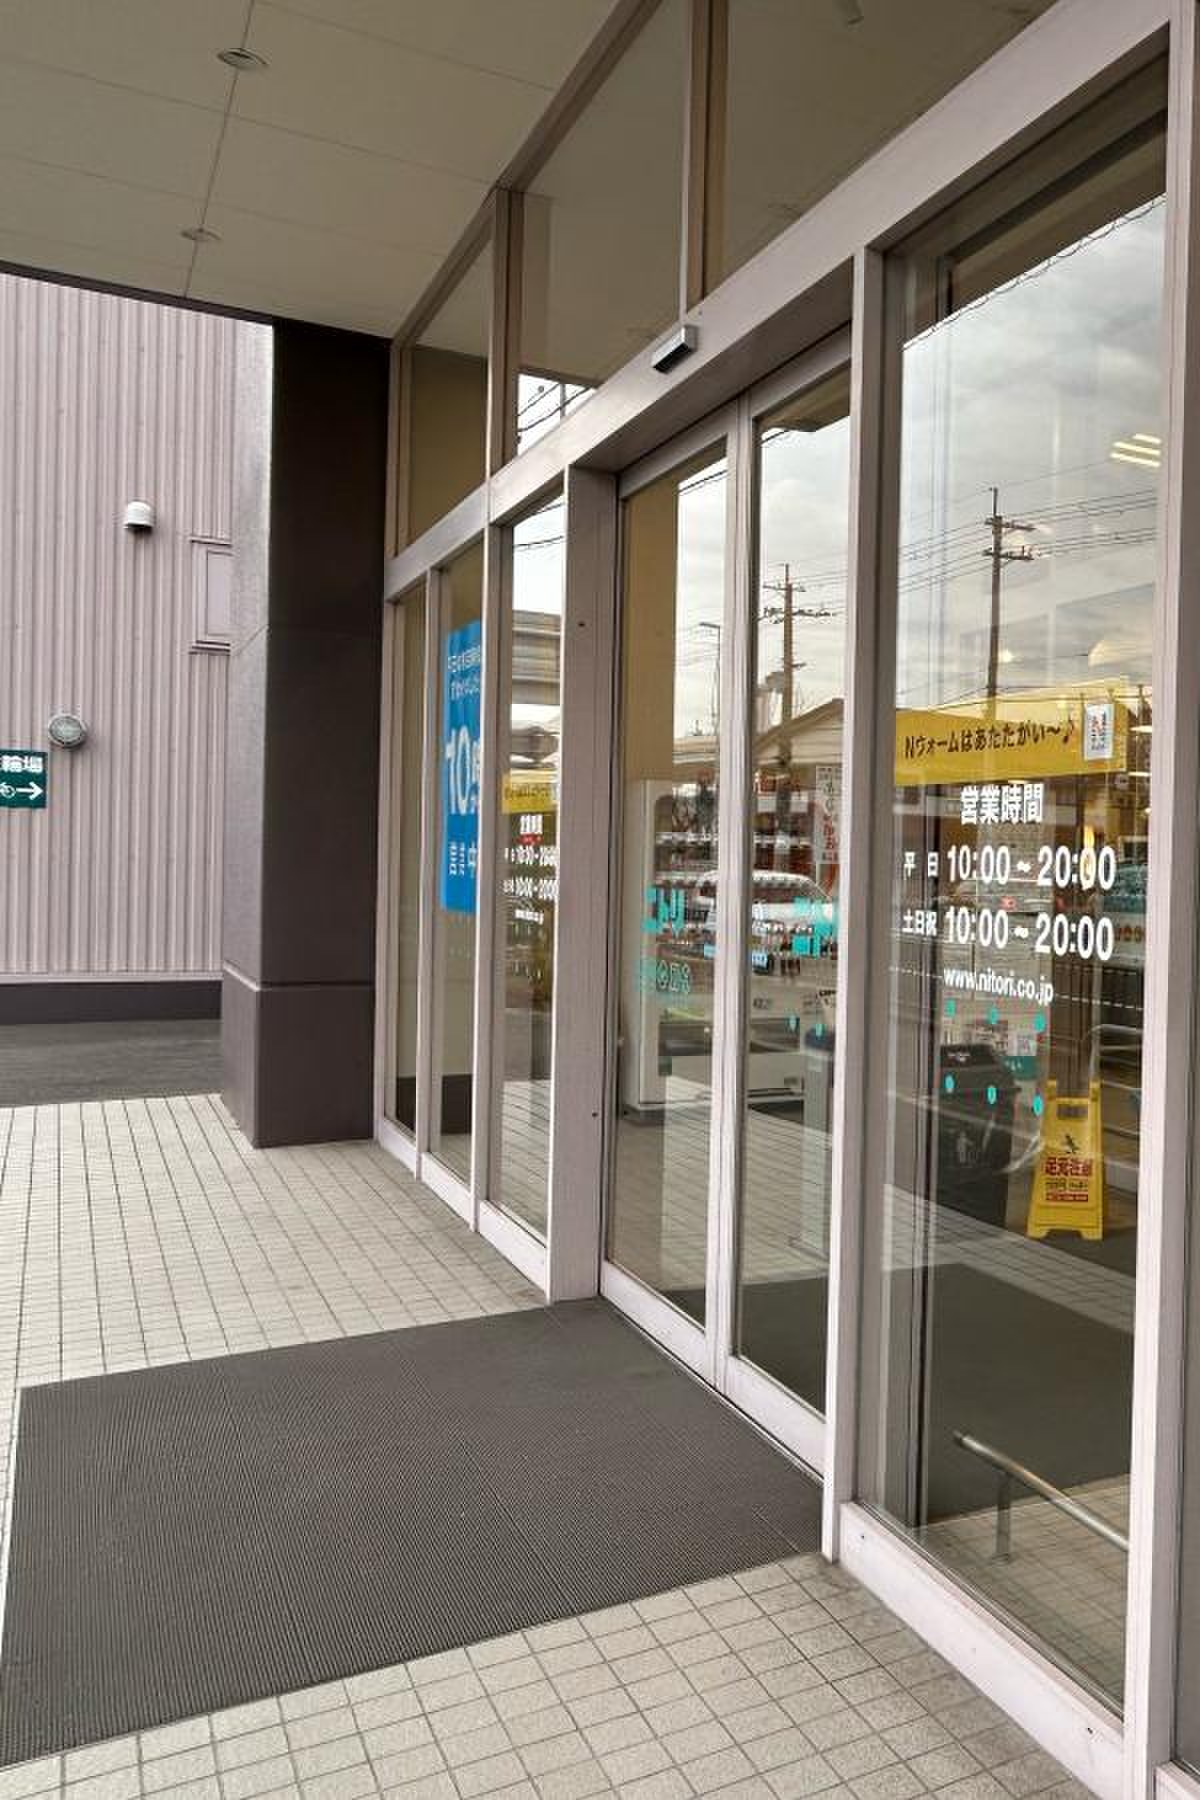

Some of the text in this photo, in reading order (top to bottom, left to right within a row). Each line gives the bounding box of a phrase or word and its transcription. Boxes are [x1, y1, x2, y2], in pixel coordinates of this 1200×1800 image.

[961, 783, 1044, 826] 営業時間
[903, 851, 939, 880] 平日
[943, 967, 1053, 1006] www.nitori.co.jp
